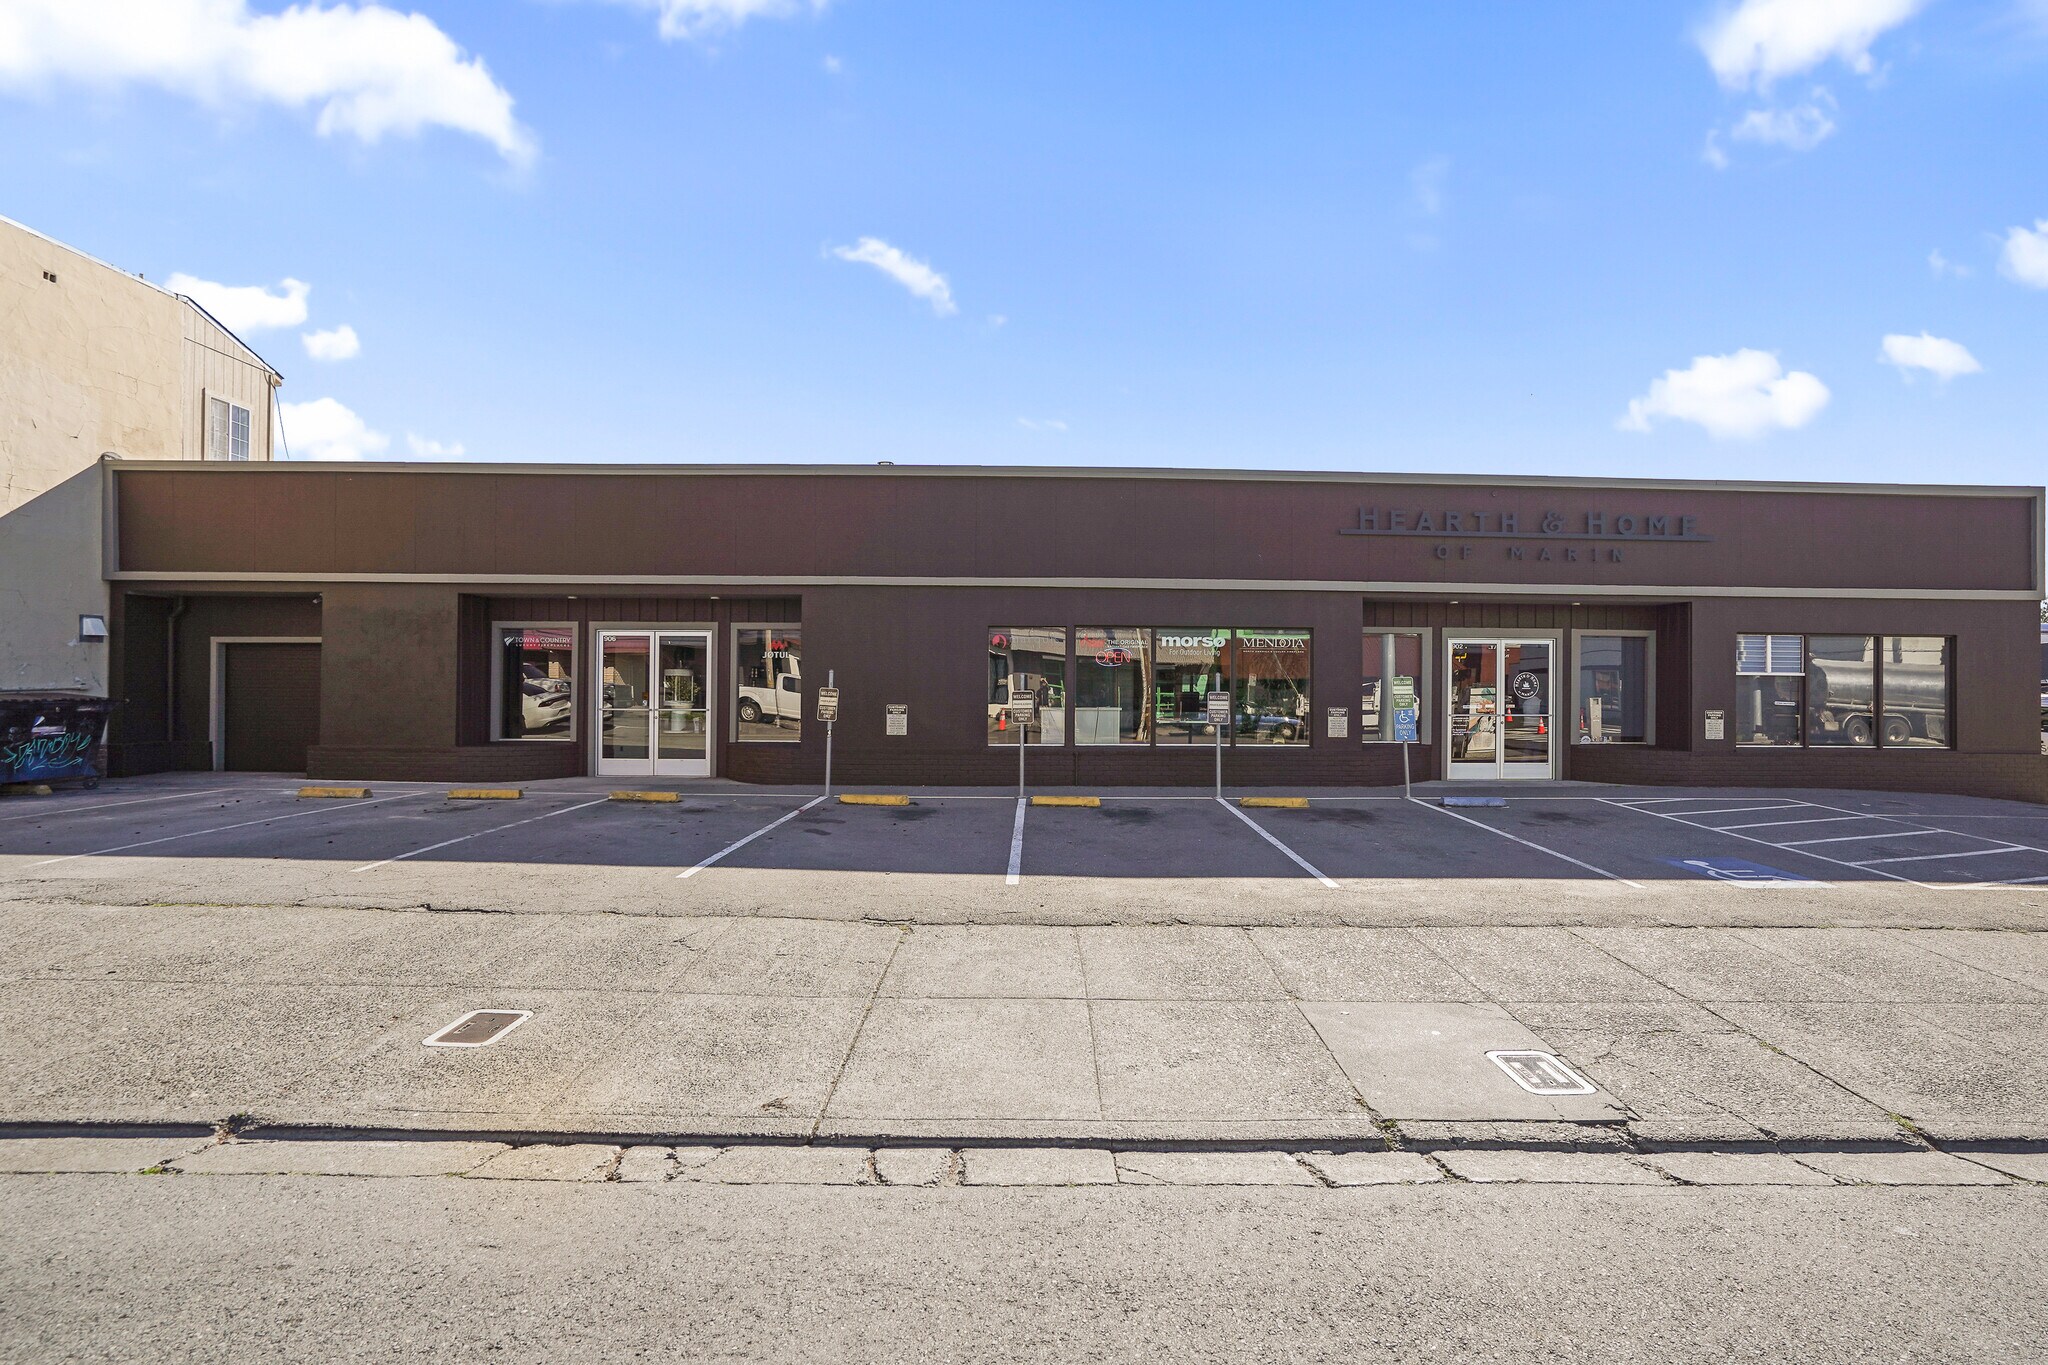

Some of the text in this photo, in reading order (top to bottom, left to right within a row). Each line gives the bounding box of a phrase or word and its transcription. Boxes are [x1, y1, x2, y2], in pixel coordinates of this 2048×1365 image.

[1359, 507, 1698, 537] HEARTH & HOME
[1435, 545, 1624, 562] OF MARIN
[1242, 638, 1305, 648] MENDOTA
[1096, 651, 1131, 663] OPEN
